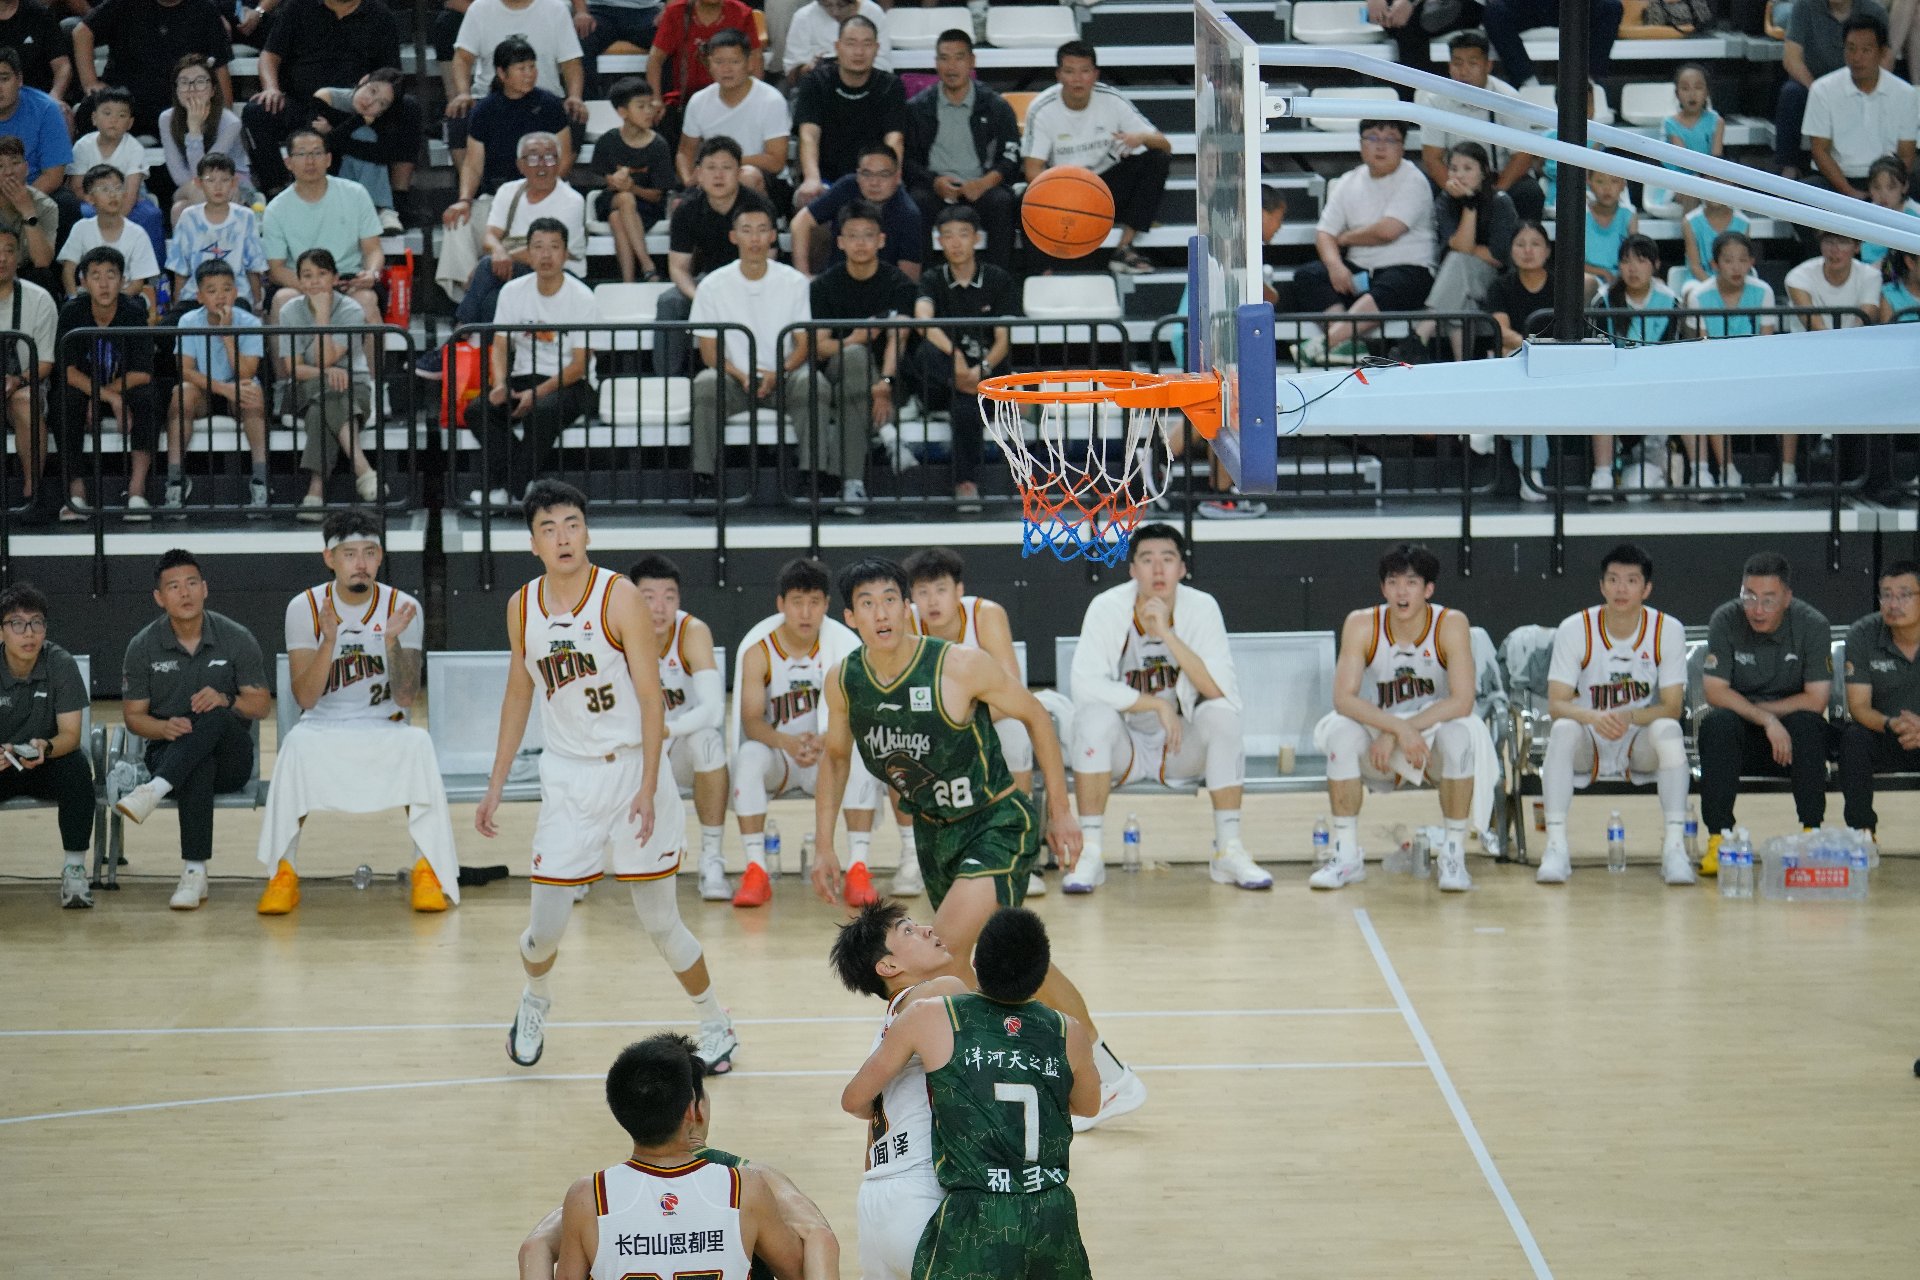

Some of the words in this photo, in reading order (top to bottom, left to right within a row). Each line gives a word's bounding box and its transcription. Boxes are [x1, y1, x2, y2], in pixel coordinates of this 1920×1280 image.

[584, 683, 616, 713] 35
[863, 725, 931, 761] Mkings
[932, 776, 974, 809] 28
[993, 1082, 1040, 1163] 7
[615, 1229, 725, 1256] 长白山恩都里
